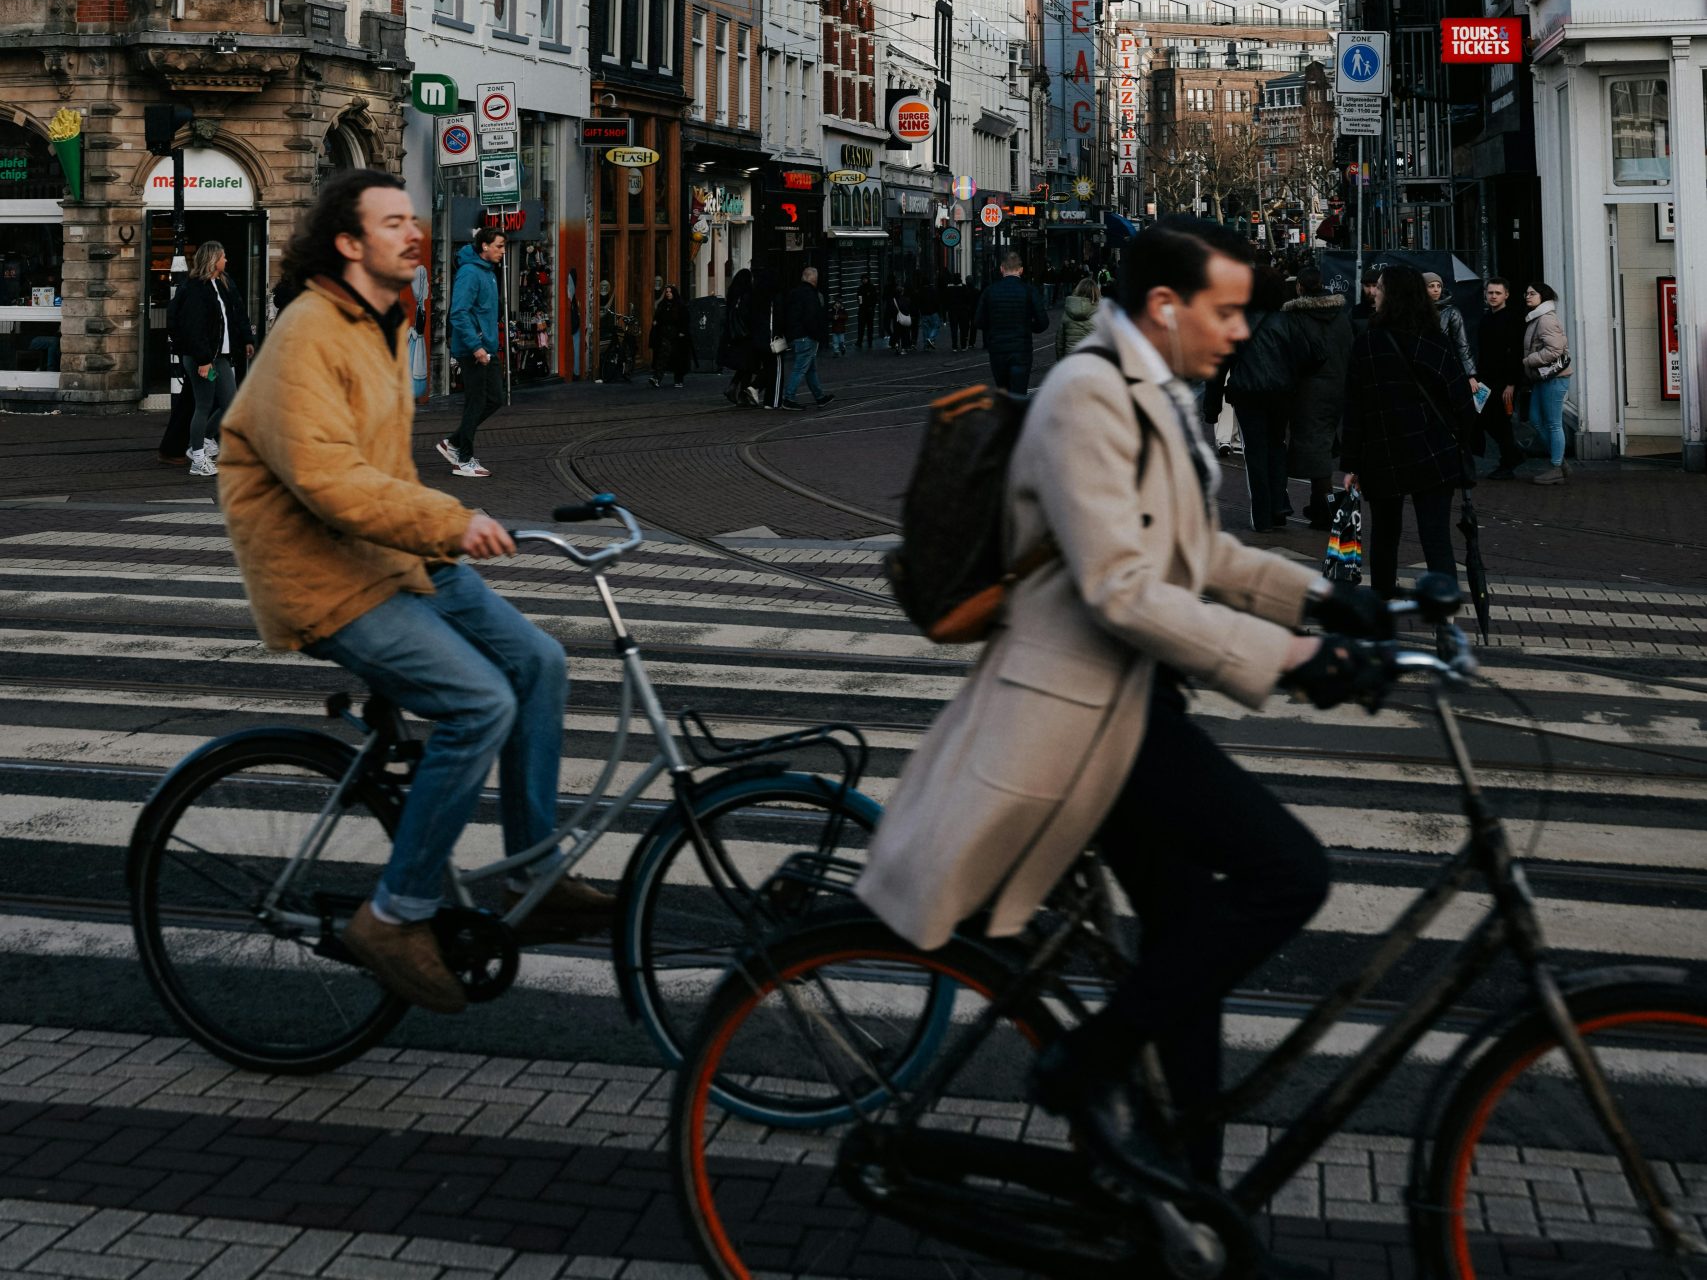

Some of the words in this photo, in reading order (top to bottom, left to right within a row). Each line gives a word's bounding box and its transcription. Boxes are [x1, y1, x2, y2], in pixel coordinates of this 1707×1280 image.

[1351, 35, 1372, 43] ZONE
[1451, 40, 1510, 55] TICKETS
[1120, 39, 1135, 174] PIZZERIA
[446, 117, 464, 125] ZONE
[899, 112, 930, 121] BURGER
[898, 120, 930, 131] KING
[584, 128, 603, 137] GIFT
[603, 128, 627, 137] SHOP
[613, 151, 653, 163] FLASH
[0, 158, 27, 168] alafel
[0, 169, 28, 181] chips
[834, 173, 862, 182] FLASH
[985, 207, 999, 215] DN
[505, 210, 527, 231] SHOP
